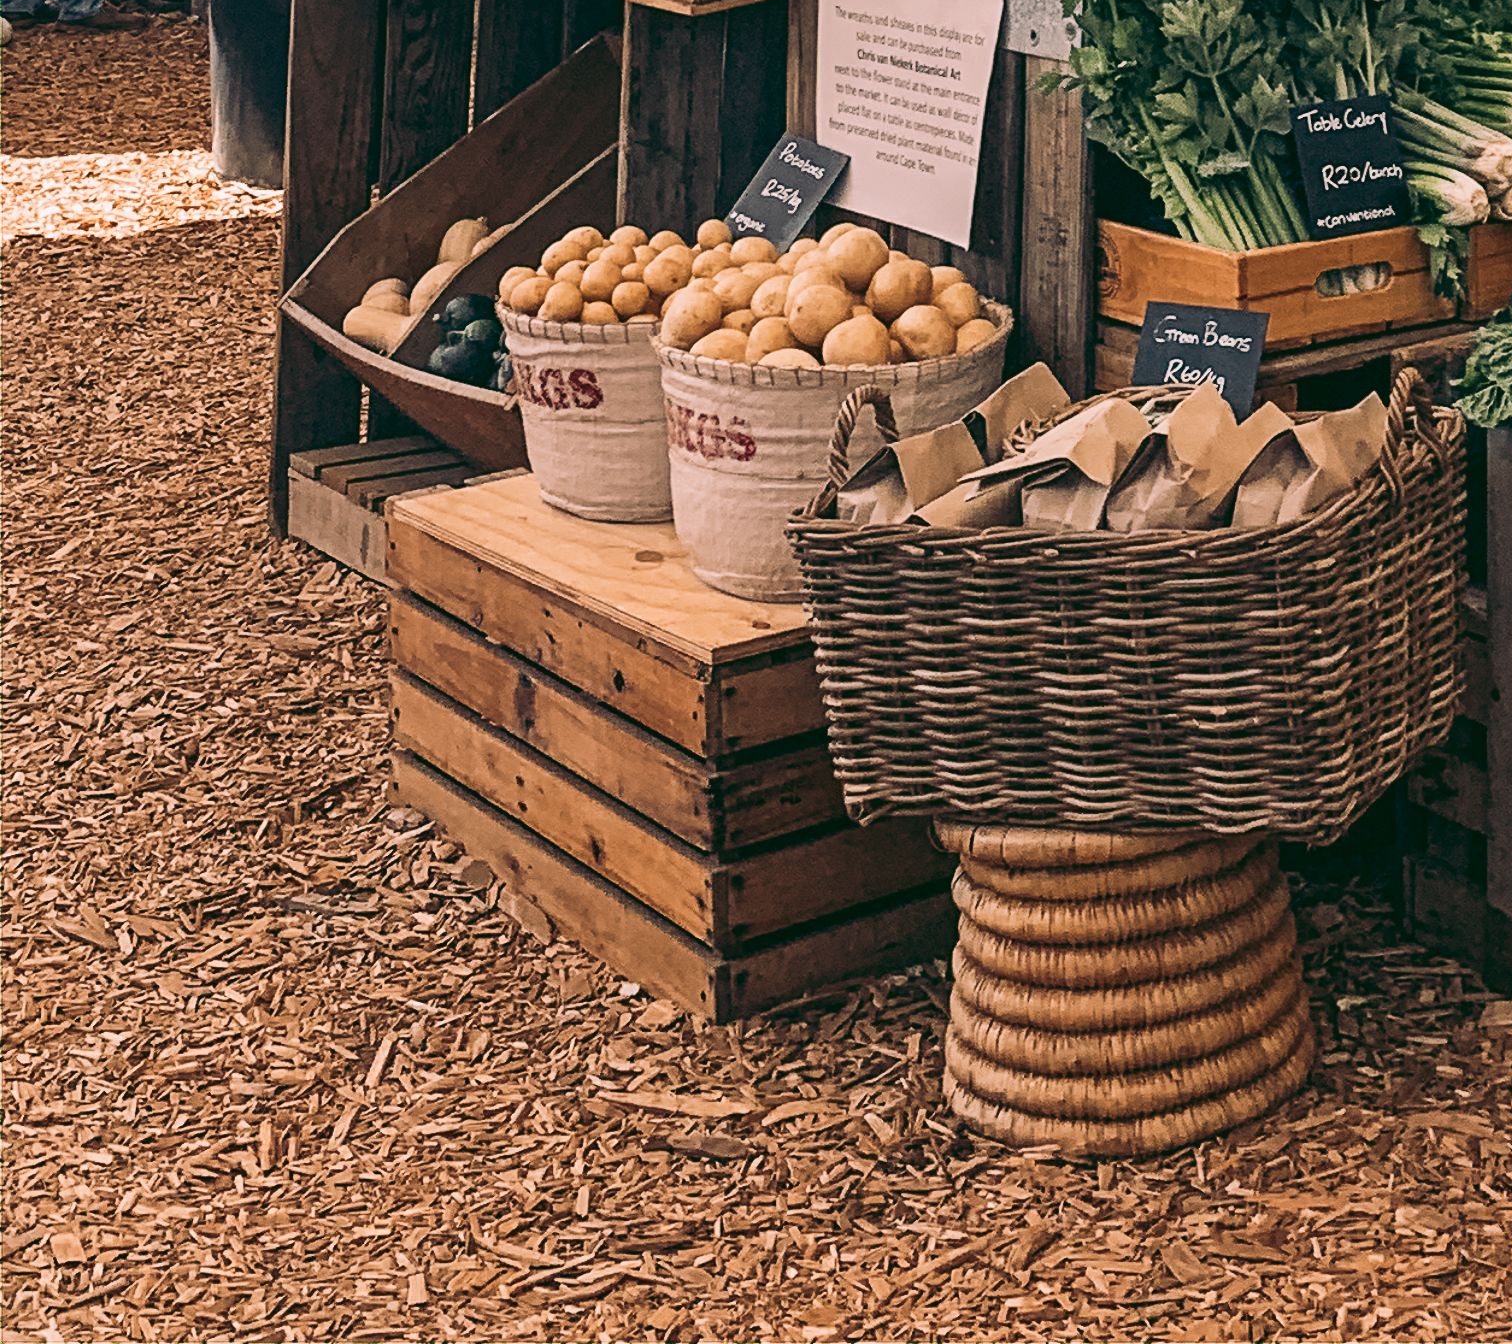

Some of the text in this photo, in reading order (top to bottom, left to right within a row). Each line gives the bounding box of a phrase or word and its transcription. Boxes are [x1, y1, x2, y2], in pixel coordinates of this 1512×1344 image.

[939, 26, 961, 45] display
[857, 48, 876, 62] Chris
[876, 54, 889, 65] van
[915, 60, 949, 78] Botanical
[950, 67, 961, 81] Art
[845, 83, 857, 97] the
[860, 67, 873, 81] the
[920, 83, 932, 96] the
[1297, 108, 1388, 135] Table Celery
[778, 141, 826, 180] Potatoes
[899, 153, 916, 170] Cape
[1321, 161, 1403, 191] R20/bunch
[760, 178, 803, 215] R25/kg
[1152, 315, 1252, 352] Green Beans
